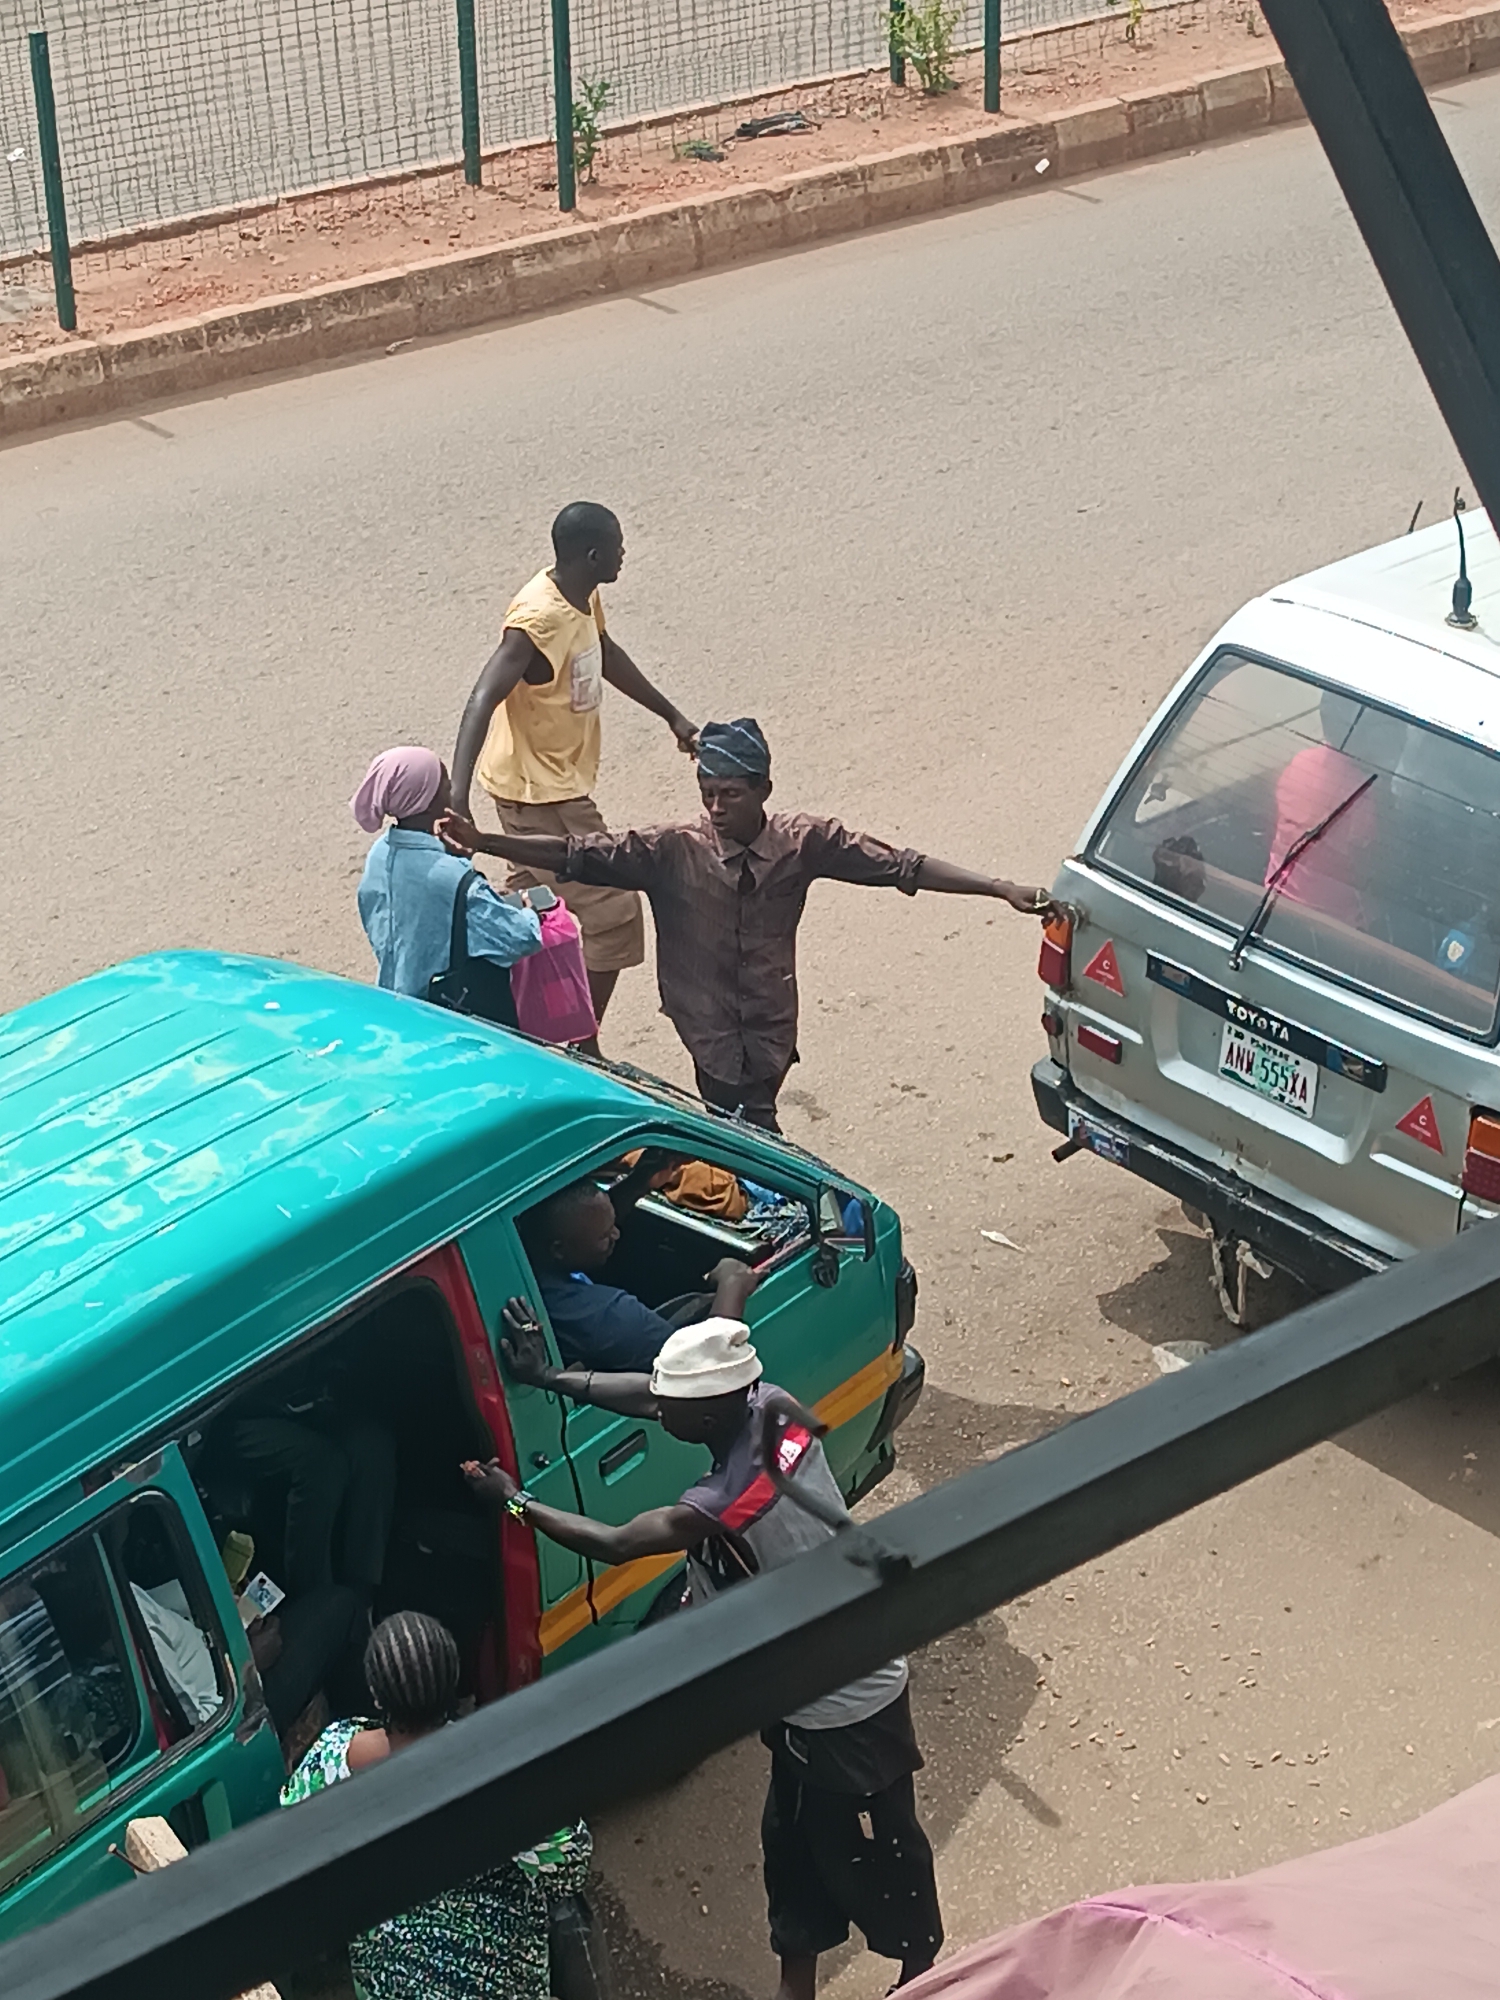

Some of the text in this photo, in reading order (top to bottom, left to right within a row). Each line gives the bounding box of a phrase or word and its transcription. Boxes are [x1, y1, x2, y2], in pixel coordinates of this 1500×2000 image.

[1102, 959, 1111, 970] C
[1226, 999, 1289, 1041] TOYOTA
[1418, 1114, 1428, 1126] C
